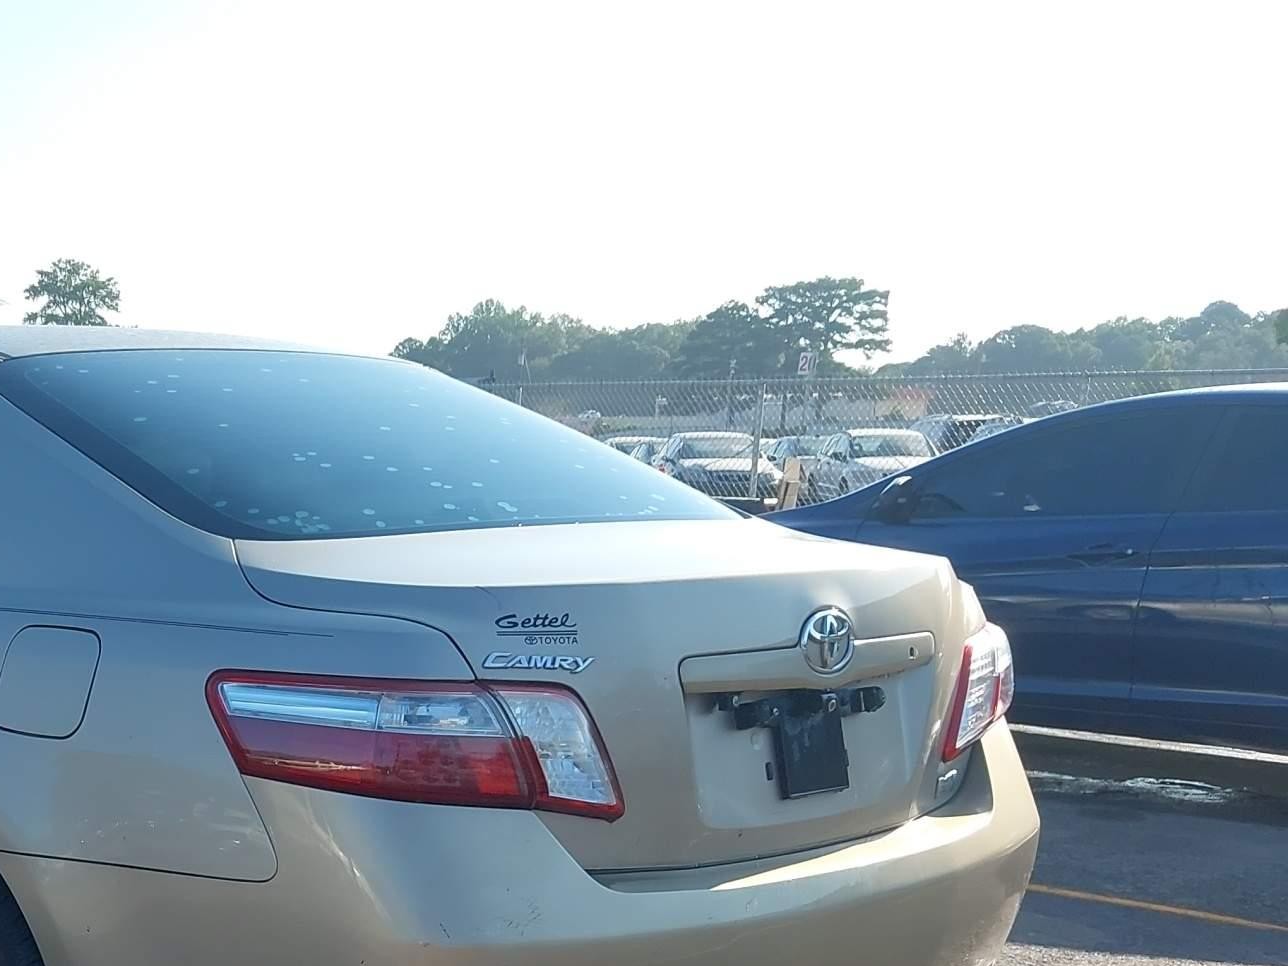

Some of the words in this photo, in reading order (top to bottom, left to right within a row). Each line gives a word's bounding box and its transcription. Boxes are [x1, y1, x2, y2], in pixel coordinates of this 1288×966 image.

[494, 612, 577, 629] Gettel
[539, 636, 578, 645] TOYOTA
[481, 651, 595, 675] CAMRY
